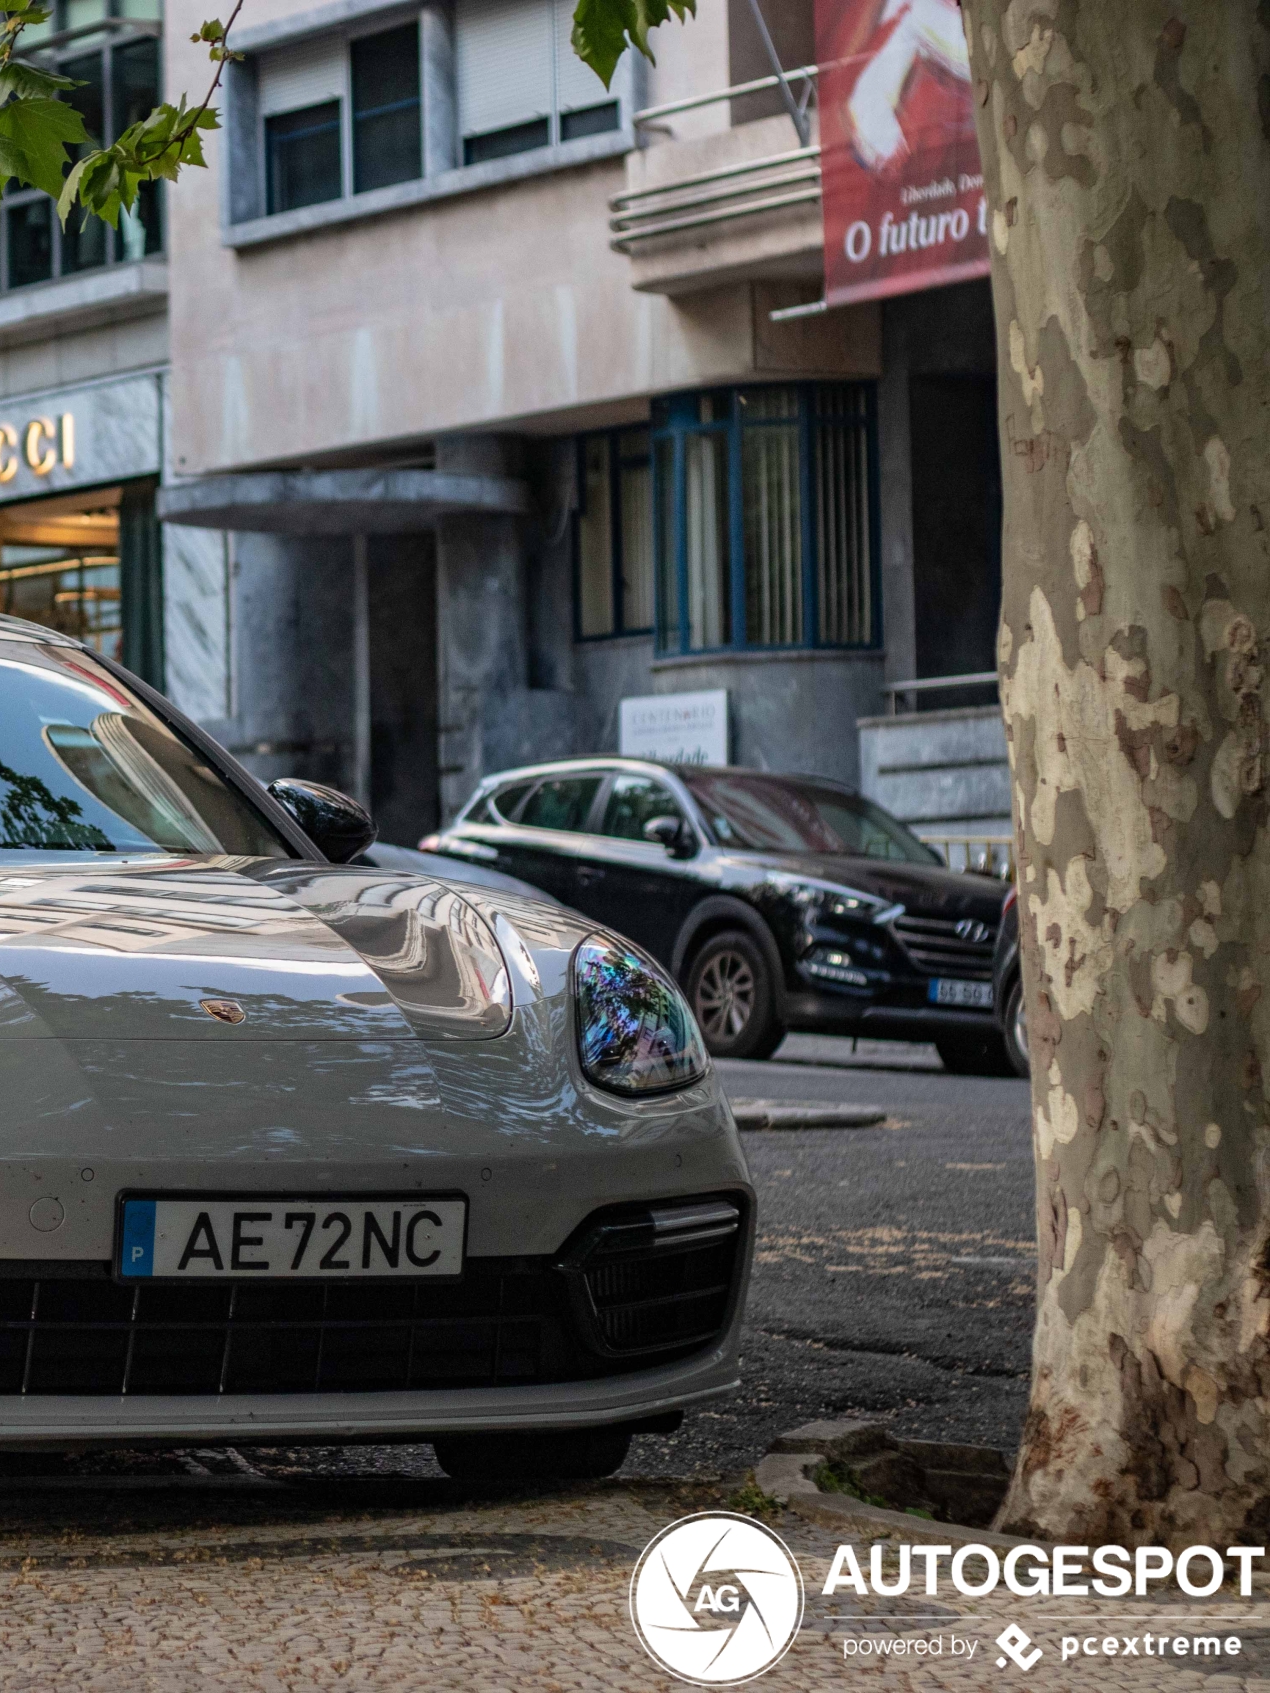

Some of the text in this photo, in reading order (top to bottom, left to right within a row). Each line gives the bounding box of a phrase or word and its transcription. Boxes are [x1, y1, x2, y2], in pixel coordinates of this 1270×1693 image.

[845, 220, 872, 263] O
[879, 210, 970, 257] futuro
[131, 1210, 443, 1271] P AE72NC
